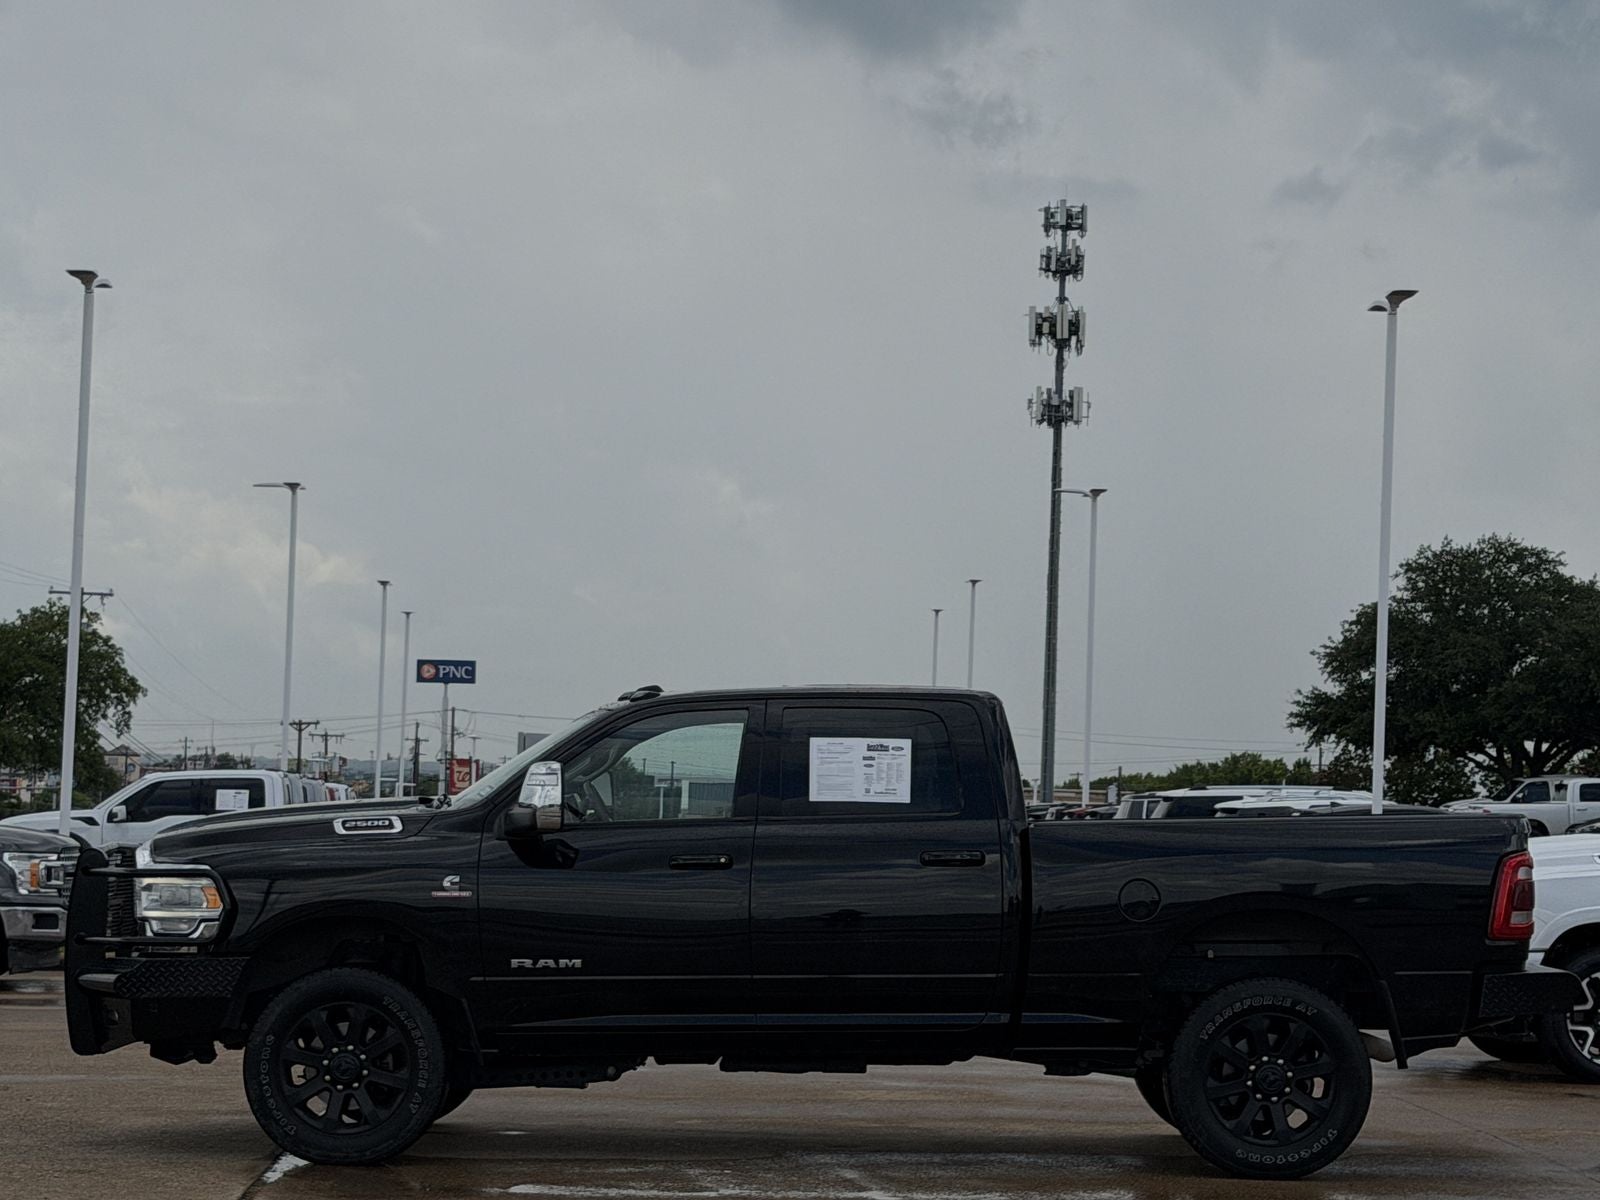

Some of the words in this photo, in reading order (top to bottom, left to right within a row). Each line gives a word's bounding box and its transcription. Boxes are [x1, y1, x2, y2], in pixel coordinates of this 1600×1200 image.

[438, 665, 472, 679] PNC
[344, 820, 390, 828] 2500
[510, 958, 583, 969] RAM
[1295, 1002, 1318, 1016] AT
